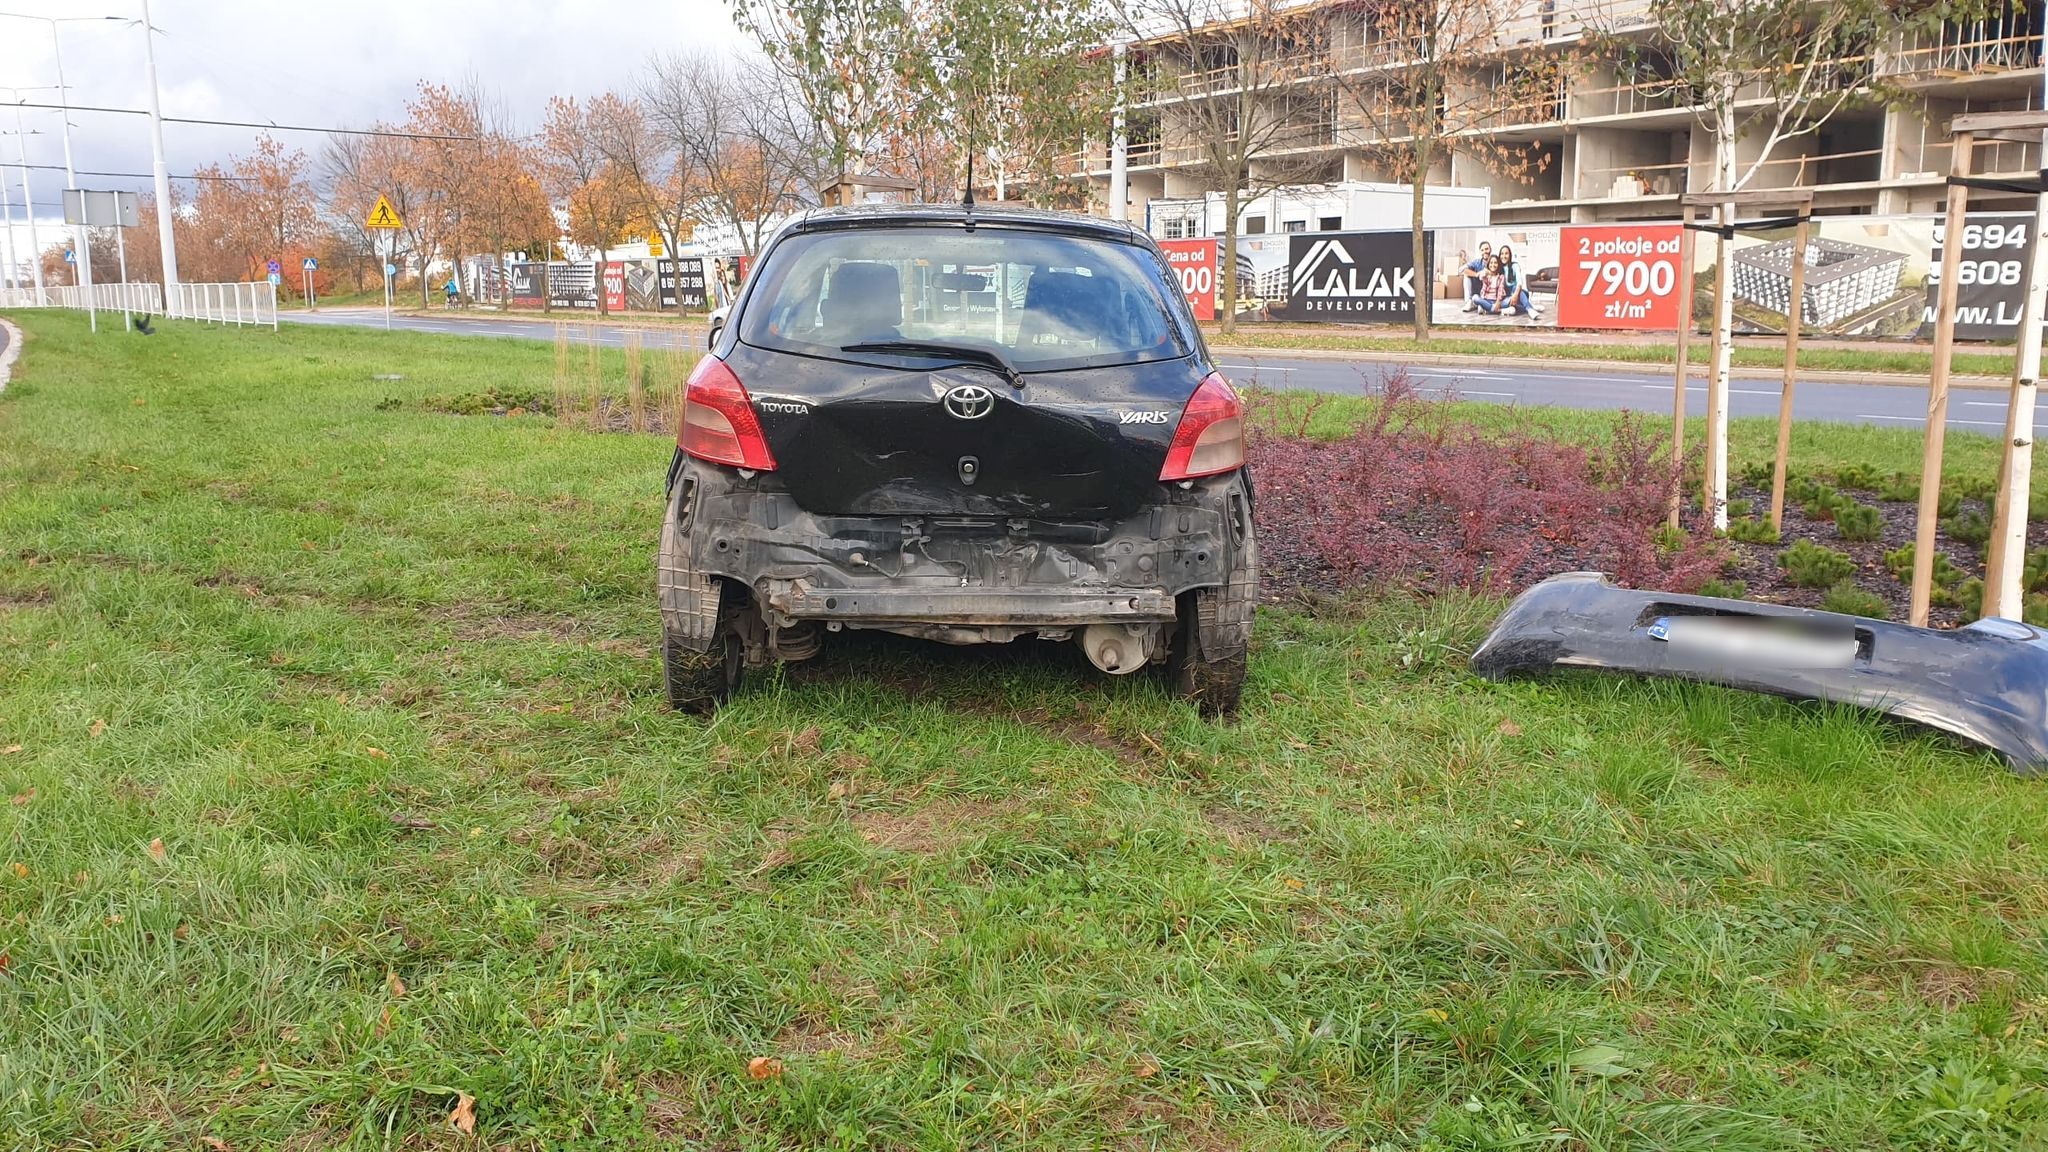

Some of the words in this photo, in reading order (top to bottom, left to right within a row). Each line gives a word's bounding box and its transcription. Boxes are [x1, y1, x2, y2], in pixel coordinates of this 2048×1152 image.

[1578, 237, 1591, 255] 2
[1594, 236, 1653, 257] pokoje
[1656, 235, 1680, 253] od
[1961, 224, 2027, 249] 694
[1164, 250, 1189, 262] Cena
[1191, 247, 1205, 261] od
[1306, 267, 1415, 298] LALAK
[1579, 260, 1675, 297] 7900
[1957, 260, 2022, 286] 608
[1306, 301, 1416, 311] DEVELOPMEN
[760, 402, 809, 415] TOYOTA
[1119, 410, 1170, 425] YARIS
